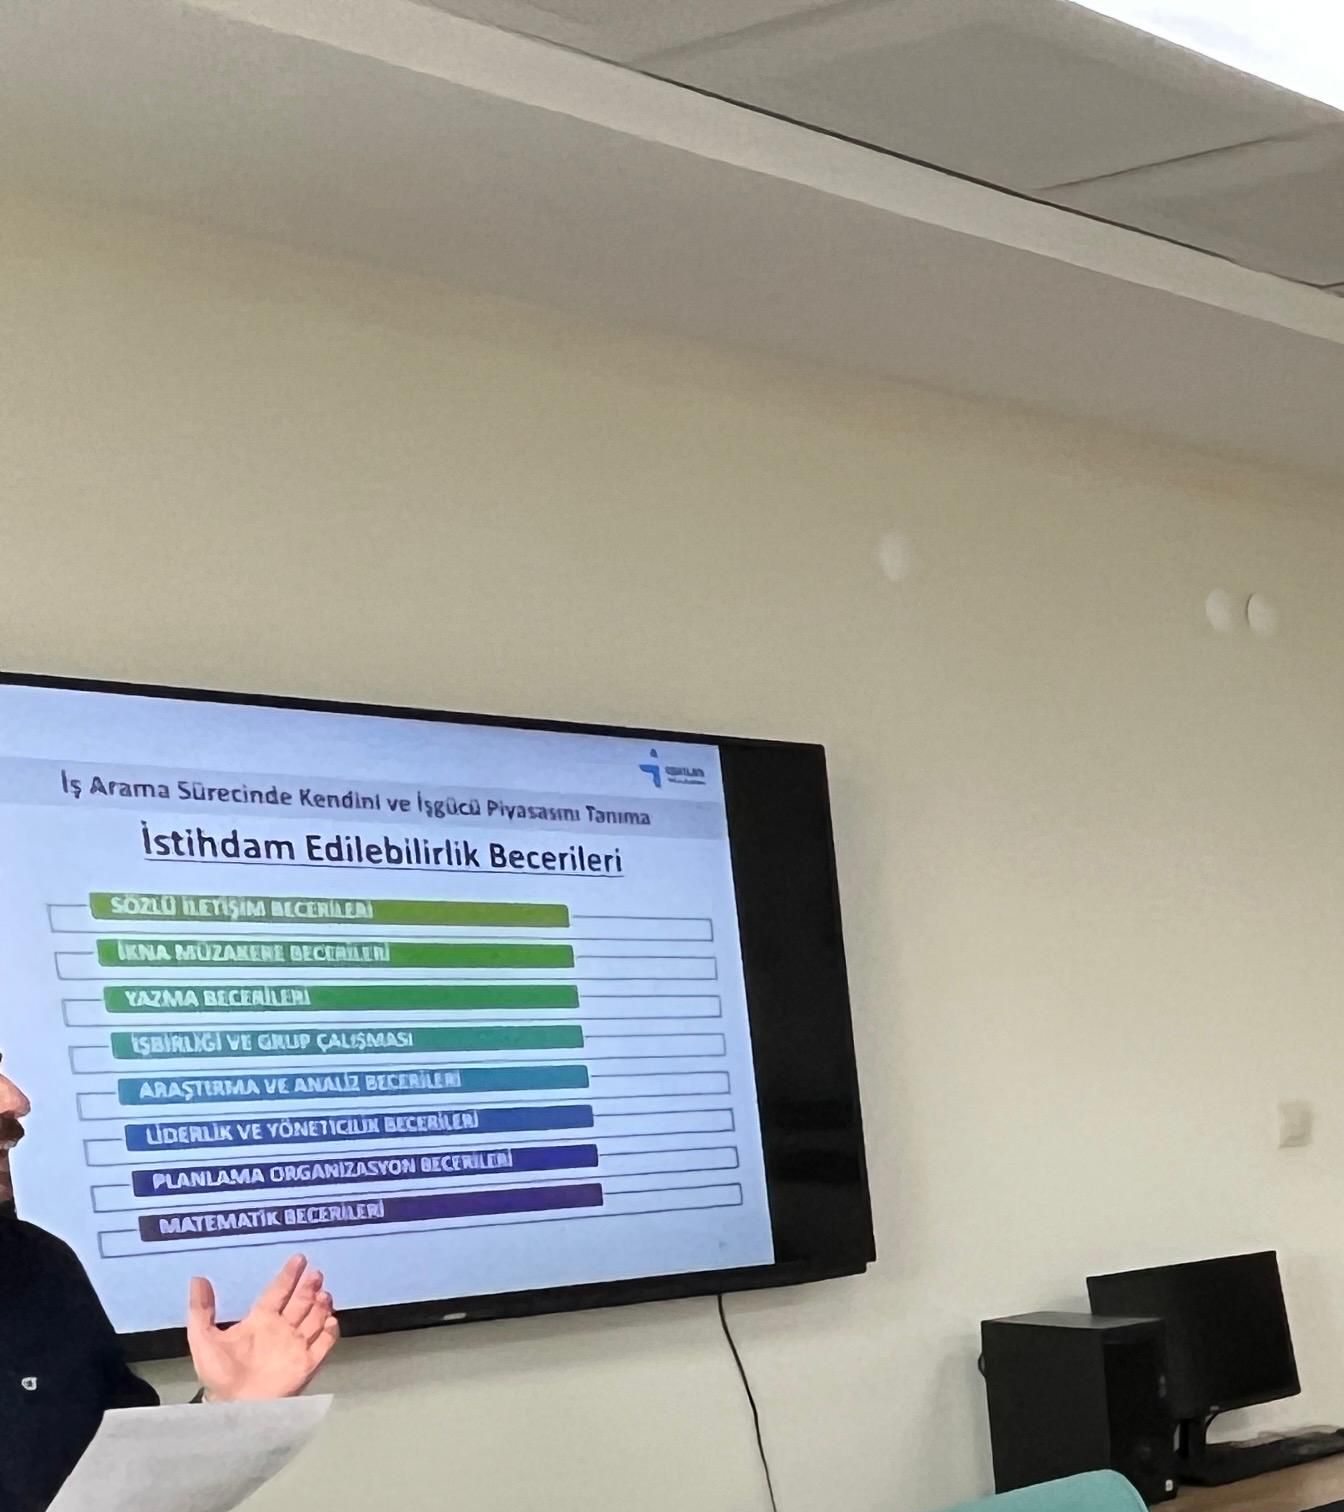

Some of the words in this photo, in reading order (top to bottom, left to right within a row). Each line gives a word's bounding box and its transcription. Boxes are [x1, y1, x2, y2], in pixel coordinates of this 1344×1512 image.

[90, 776, 170, 799] Arama
[177, 780, 293, 806] Sürecinde
[299, 788, 380, 811] Kendini
[387, 796, 411, 813] ve
[417, 790, 481, 820] İşgücü
[487, 799, 581, 822] Piyasasını
[586, 805, 651, 826] Tanıma
[141, 819, 296, 861] İstihdam
[305, 833, 481, 869] Edilebilirlik
[489, 842, 624, 874] Becerileri
[111, 896, 176, 917] SÖZLÜ
[117, 940, 172, 962] İKNA
[125, 989, 200, 1007] YAZMA
[227, 1034, 252, 1051] VE
[257, 1034, 311, 1050] GRUP
[317, 1031, 413, 1052] ÇALIŞMASI
[139, 1077, 260, 1101] ARAŞTIRMA
[264, 1077, 288, 1095] VE
[294, 1071, 361, 1092] ANALİZ
[146, 1122, 233, 1145] LİDERLİK
[237, 1122, 262, 1140] VE
[152, 1168, 265, 1192] PLANLAMA
[158, 1207, 280, 1234] MATEMATİK
